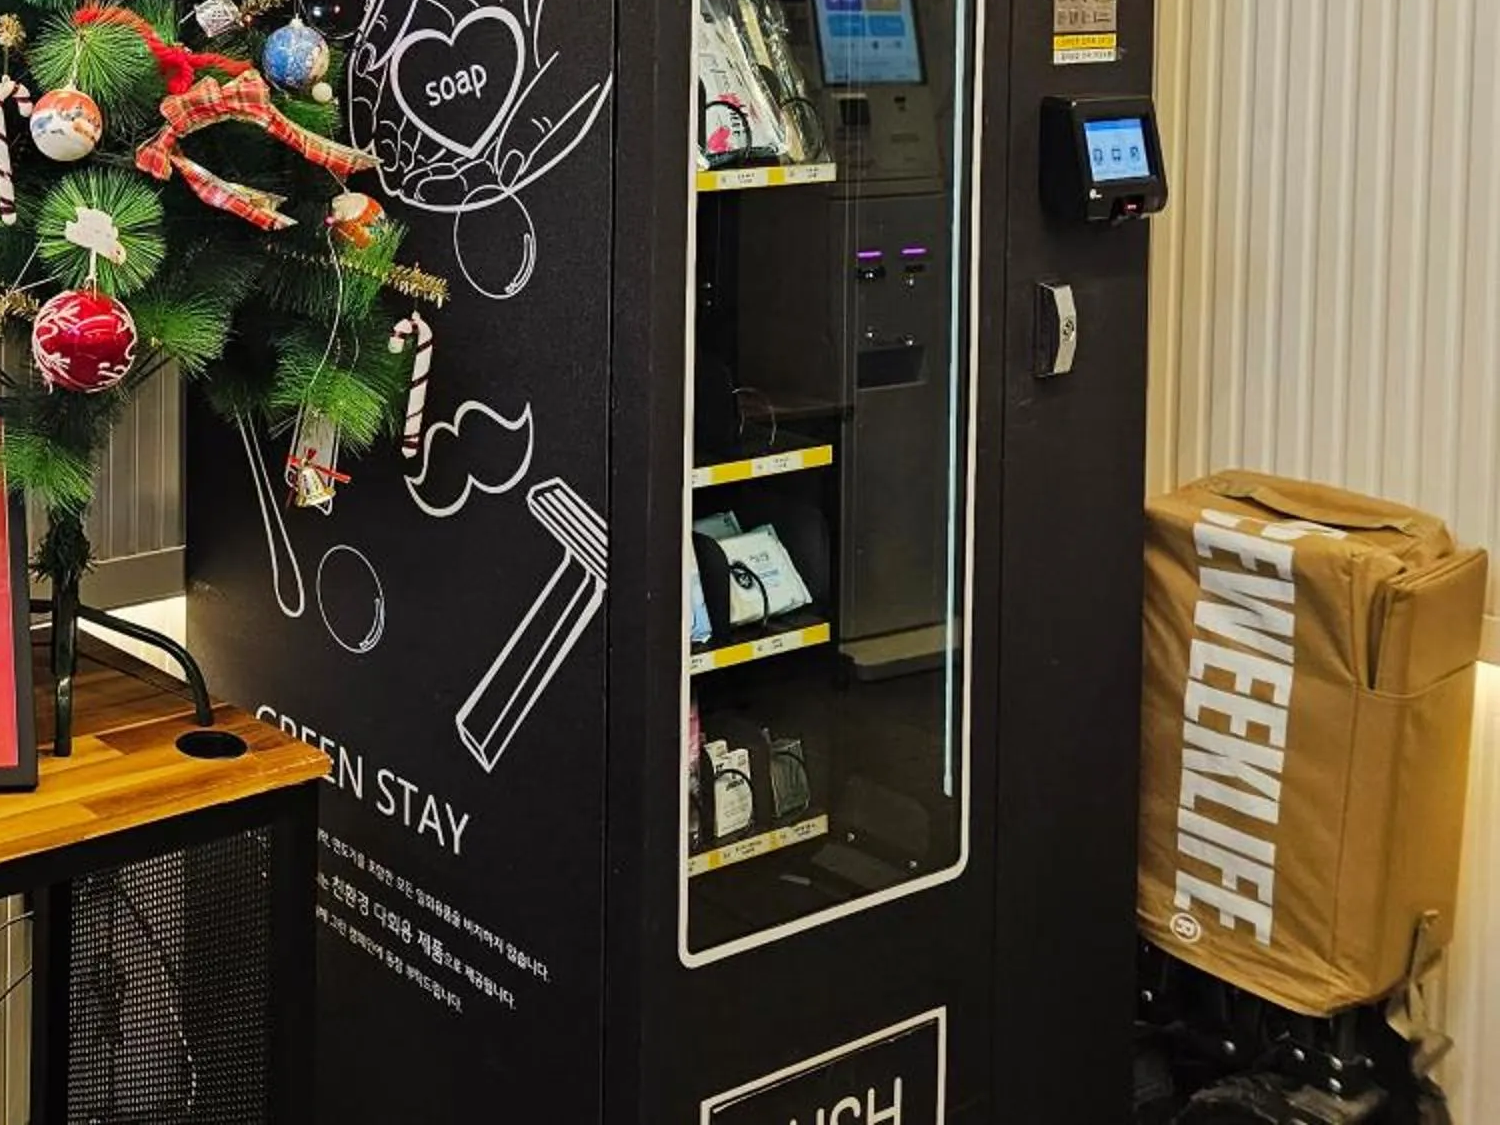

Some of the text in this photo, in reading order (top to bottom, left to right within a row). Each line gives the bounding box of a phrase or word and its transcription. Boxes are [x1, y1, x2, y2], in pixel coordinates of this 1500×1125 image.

[425, 64, 487, 107] soap
[375, 768, 469, 855] STAY
[331, 875, 369, 917] 친환경
[373, 902, 413, 944] 다회용
[417, 928, 462, 974] 제품으로
